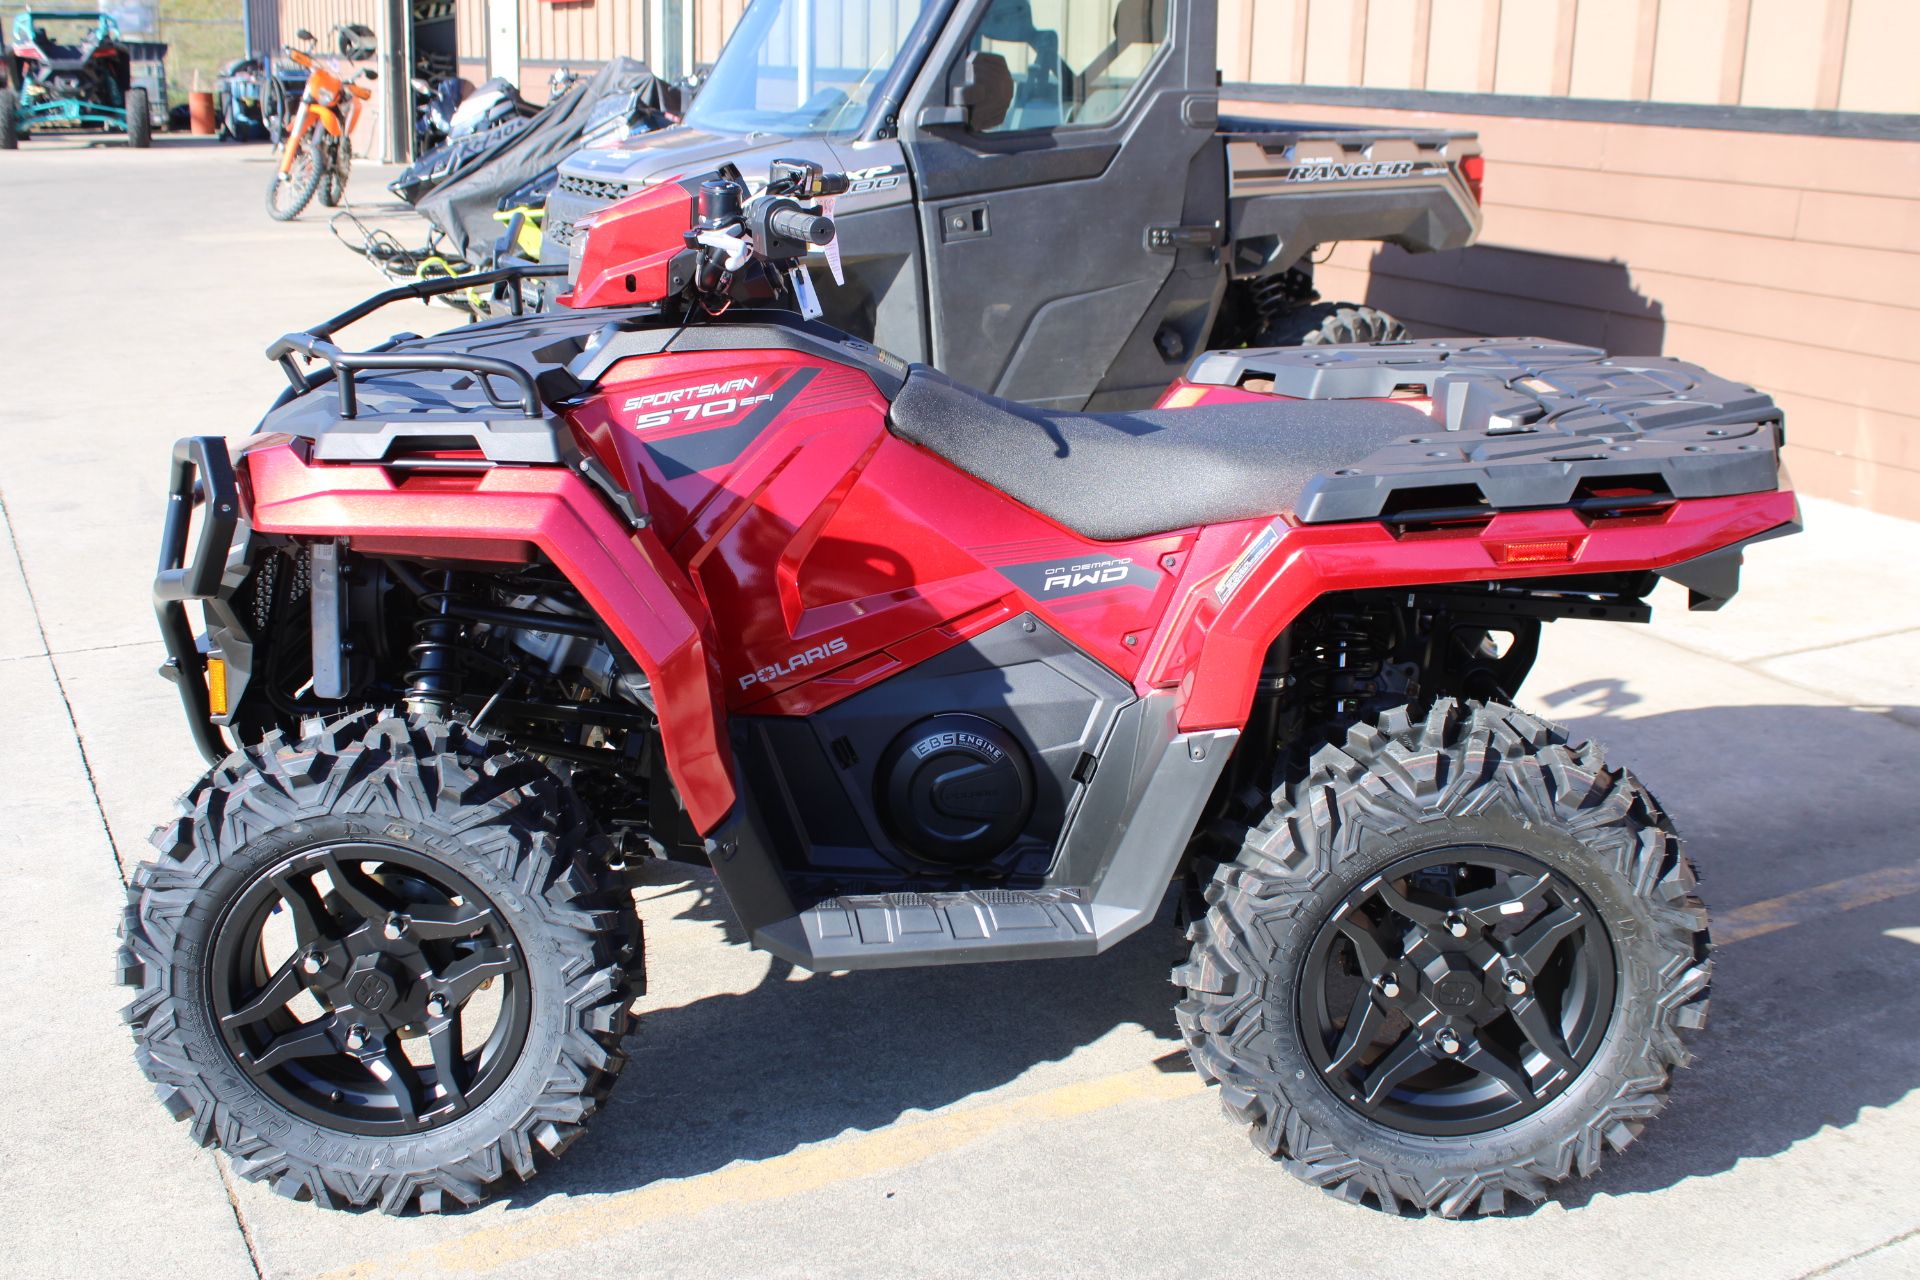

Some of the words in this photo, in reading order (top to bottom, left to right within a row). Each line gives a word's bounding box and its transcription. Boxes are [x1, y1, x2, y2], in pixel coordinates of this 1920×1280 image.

[1285, 160, 1414, 182] RANGER
[622, 376, 759, 412] SPORTSMAN
[635, 398, 737, 430] 570
[740, 393, 774, 407] EFI
[1043, 566, 1129, 591] AWD
[1045, 567, 1066, 575] ON
[1071, 558, 1132, 571] DEMAND
[738, 637, 848, 690] POLARIS
[916, 733, 954, 756] EBS
[958, 733, 1002, 758] ENGINE
